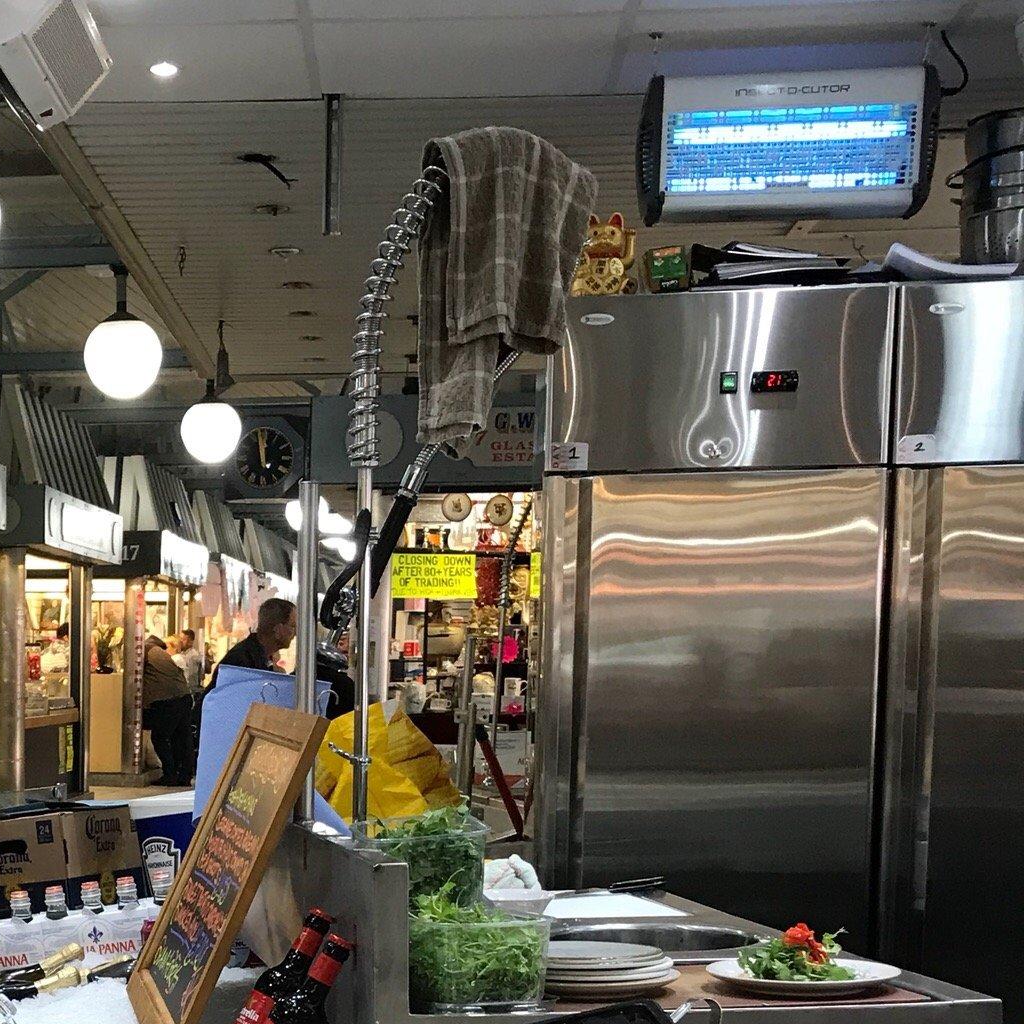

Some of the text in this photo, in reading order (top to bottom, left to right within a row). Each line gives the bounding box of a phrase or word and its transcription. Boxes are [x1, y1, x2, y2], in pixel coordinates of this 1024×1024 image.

[398, 555, 471, 566] CLOSING DOWN
[392, 566, 423, 576] AFTER
[399, 578, 411, 587] OF
[38, 825, 50, 835] 24
[85, 815, 122, 839] Corona
[95, 838, 115, 852] Extra
[146, 843, 166, 855] HEINZ
[98, 940, 136, 955] PANNA
